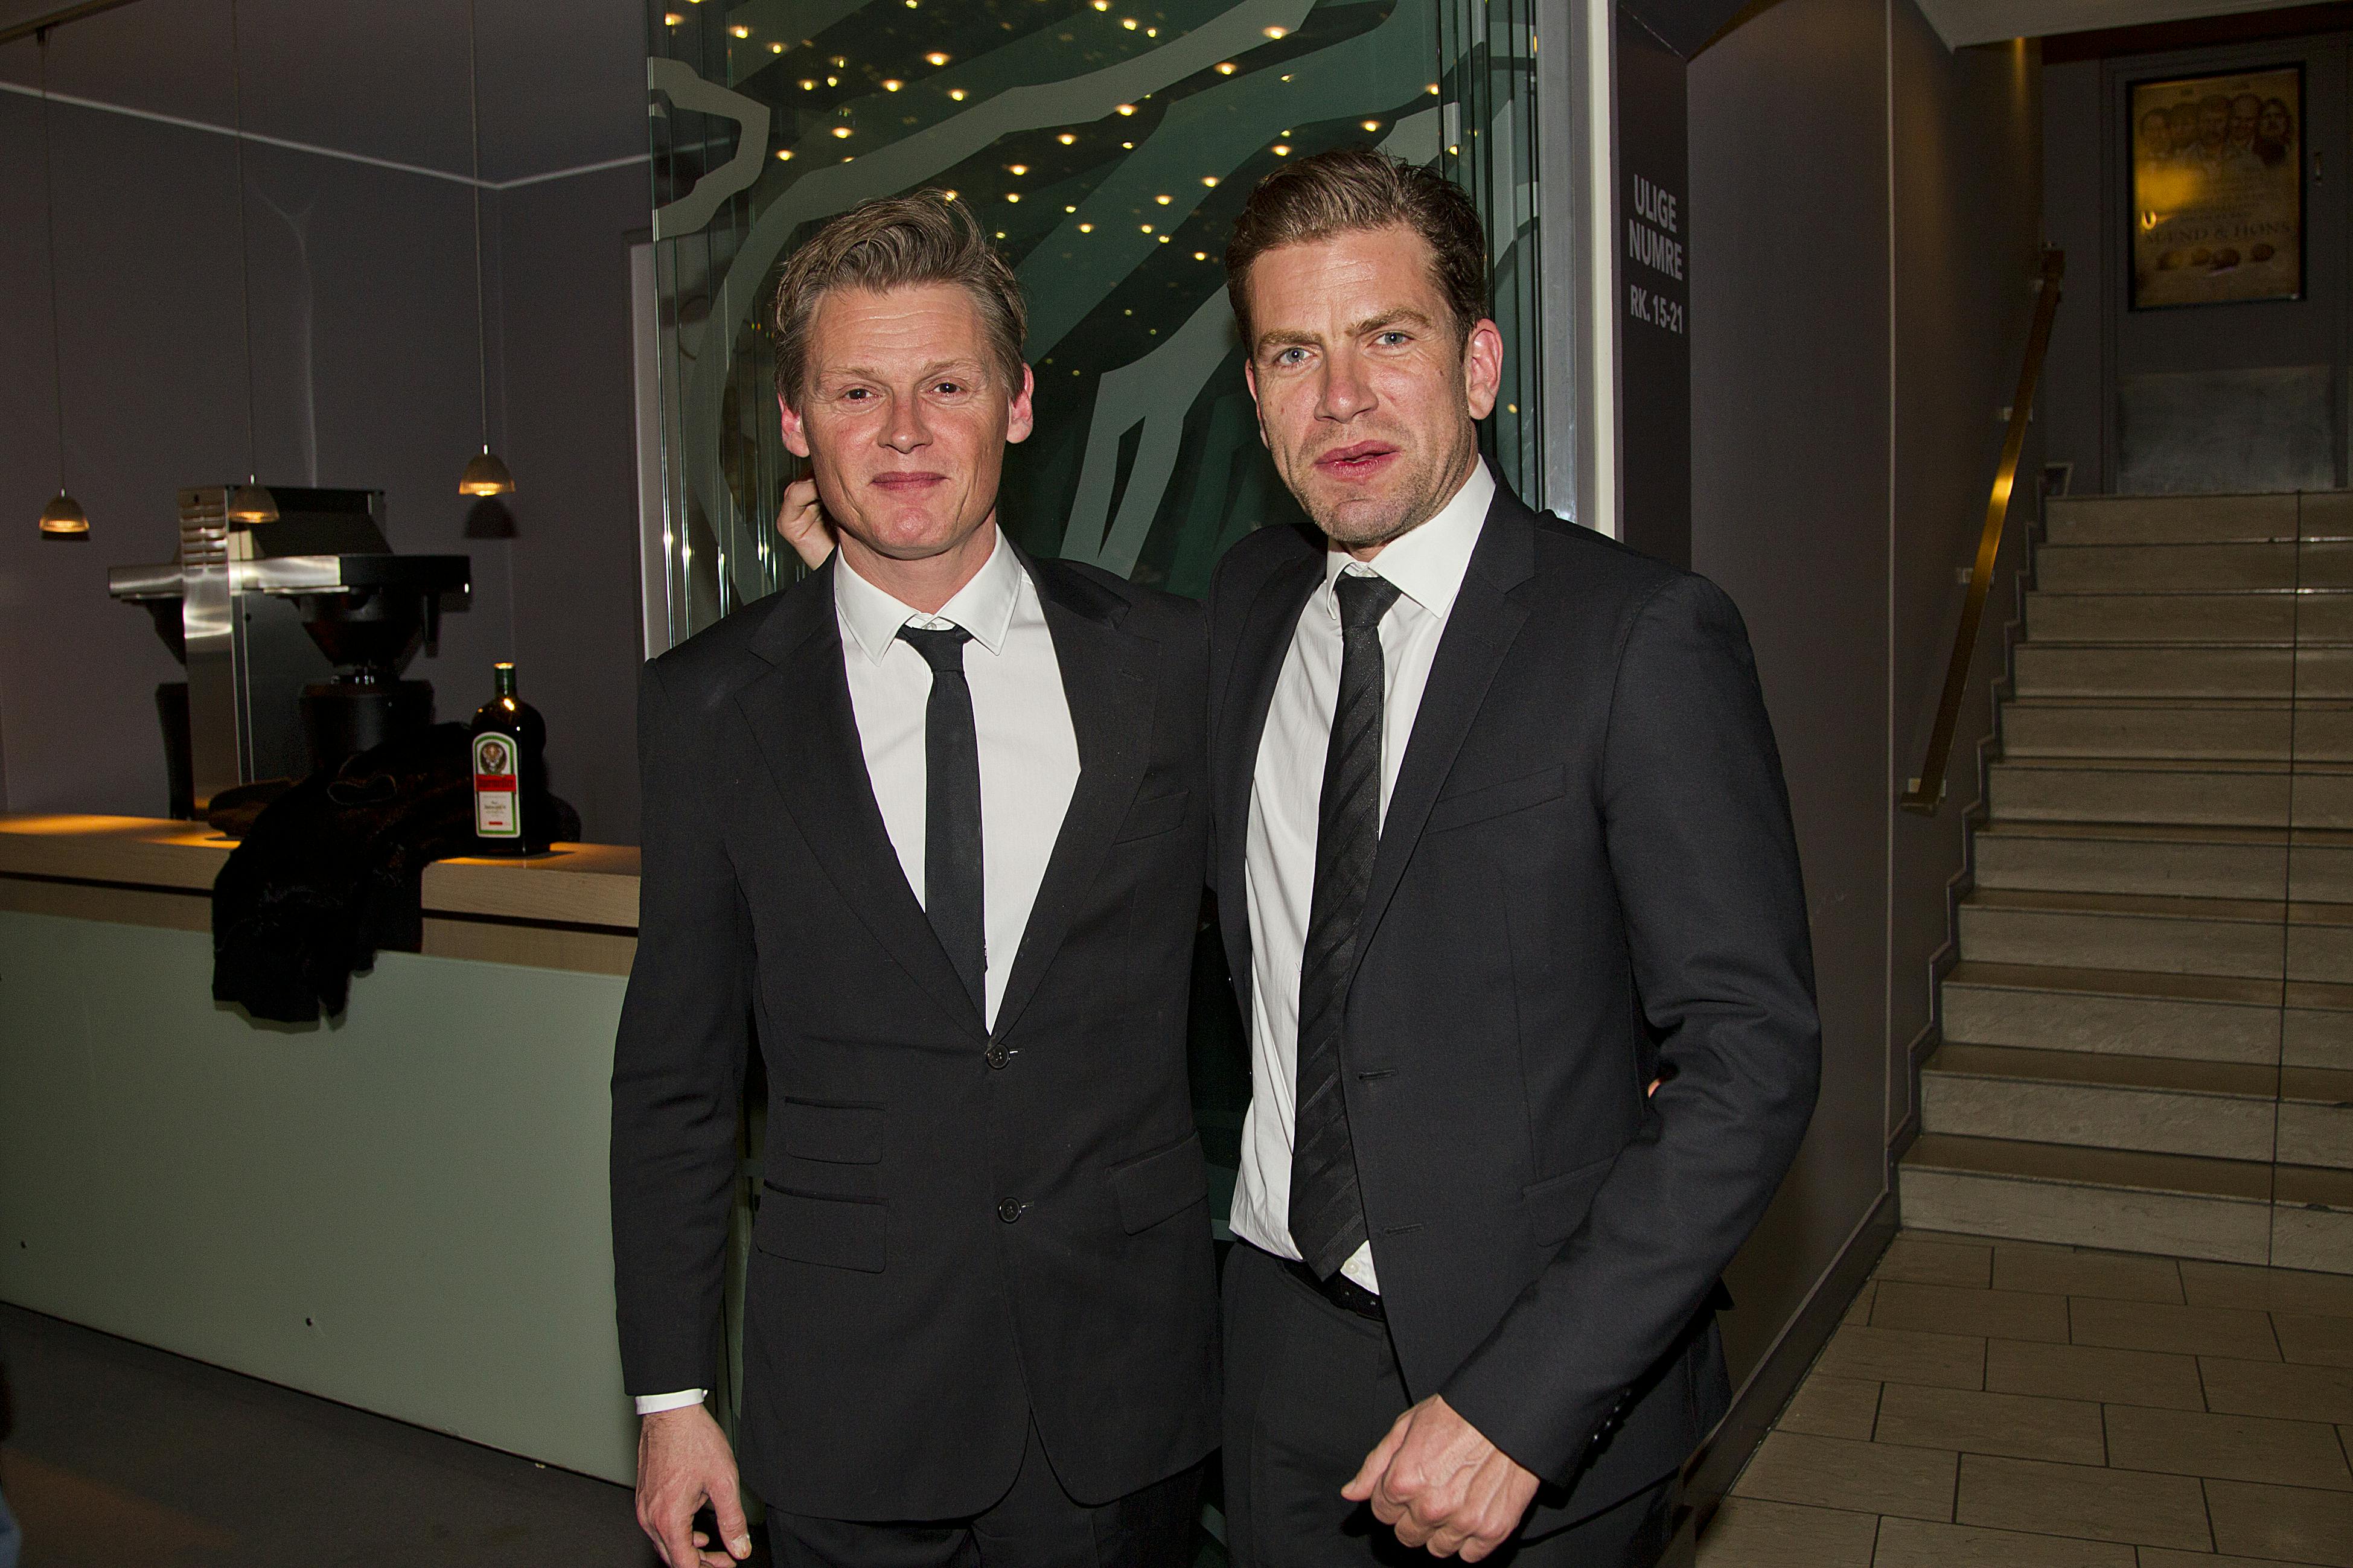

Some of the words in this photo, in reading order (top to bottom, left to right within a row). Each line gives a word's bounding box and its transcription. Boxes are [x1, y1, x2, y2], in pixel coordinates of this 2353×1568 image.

[1633, 173, 1677, 234] ULIGE
[1629, 218, 1683, 281] NUMRE
[1630, 284, 1650, 322] RK.
[1653, 294, 1683, 334] 15-21
